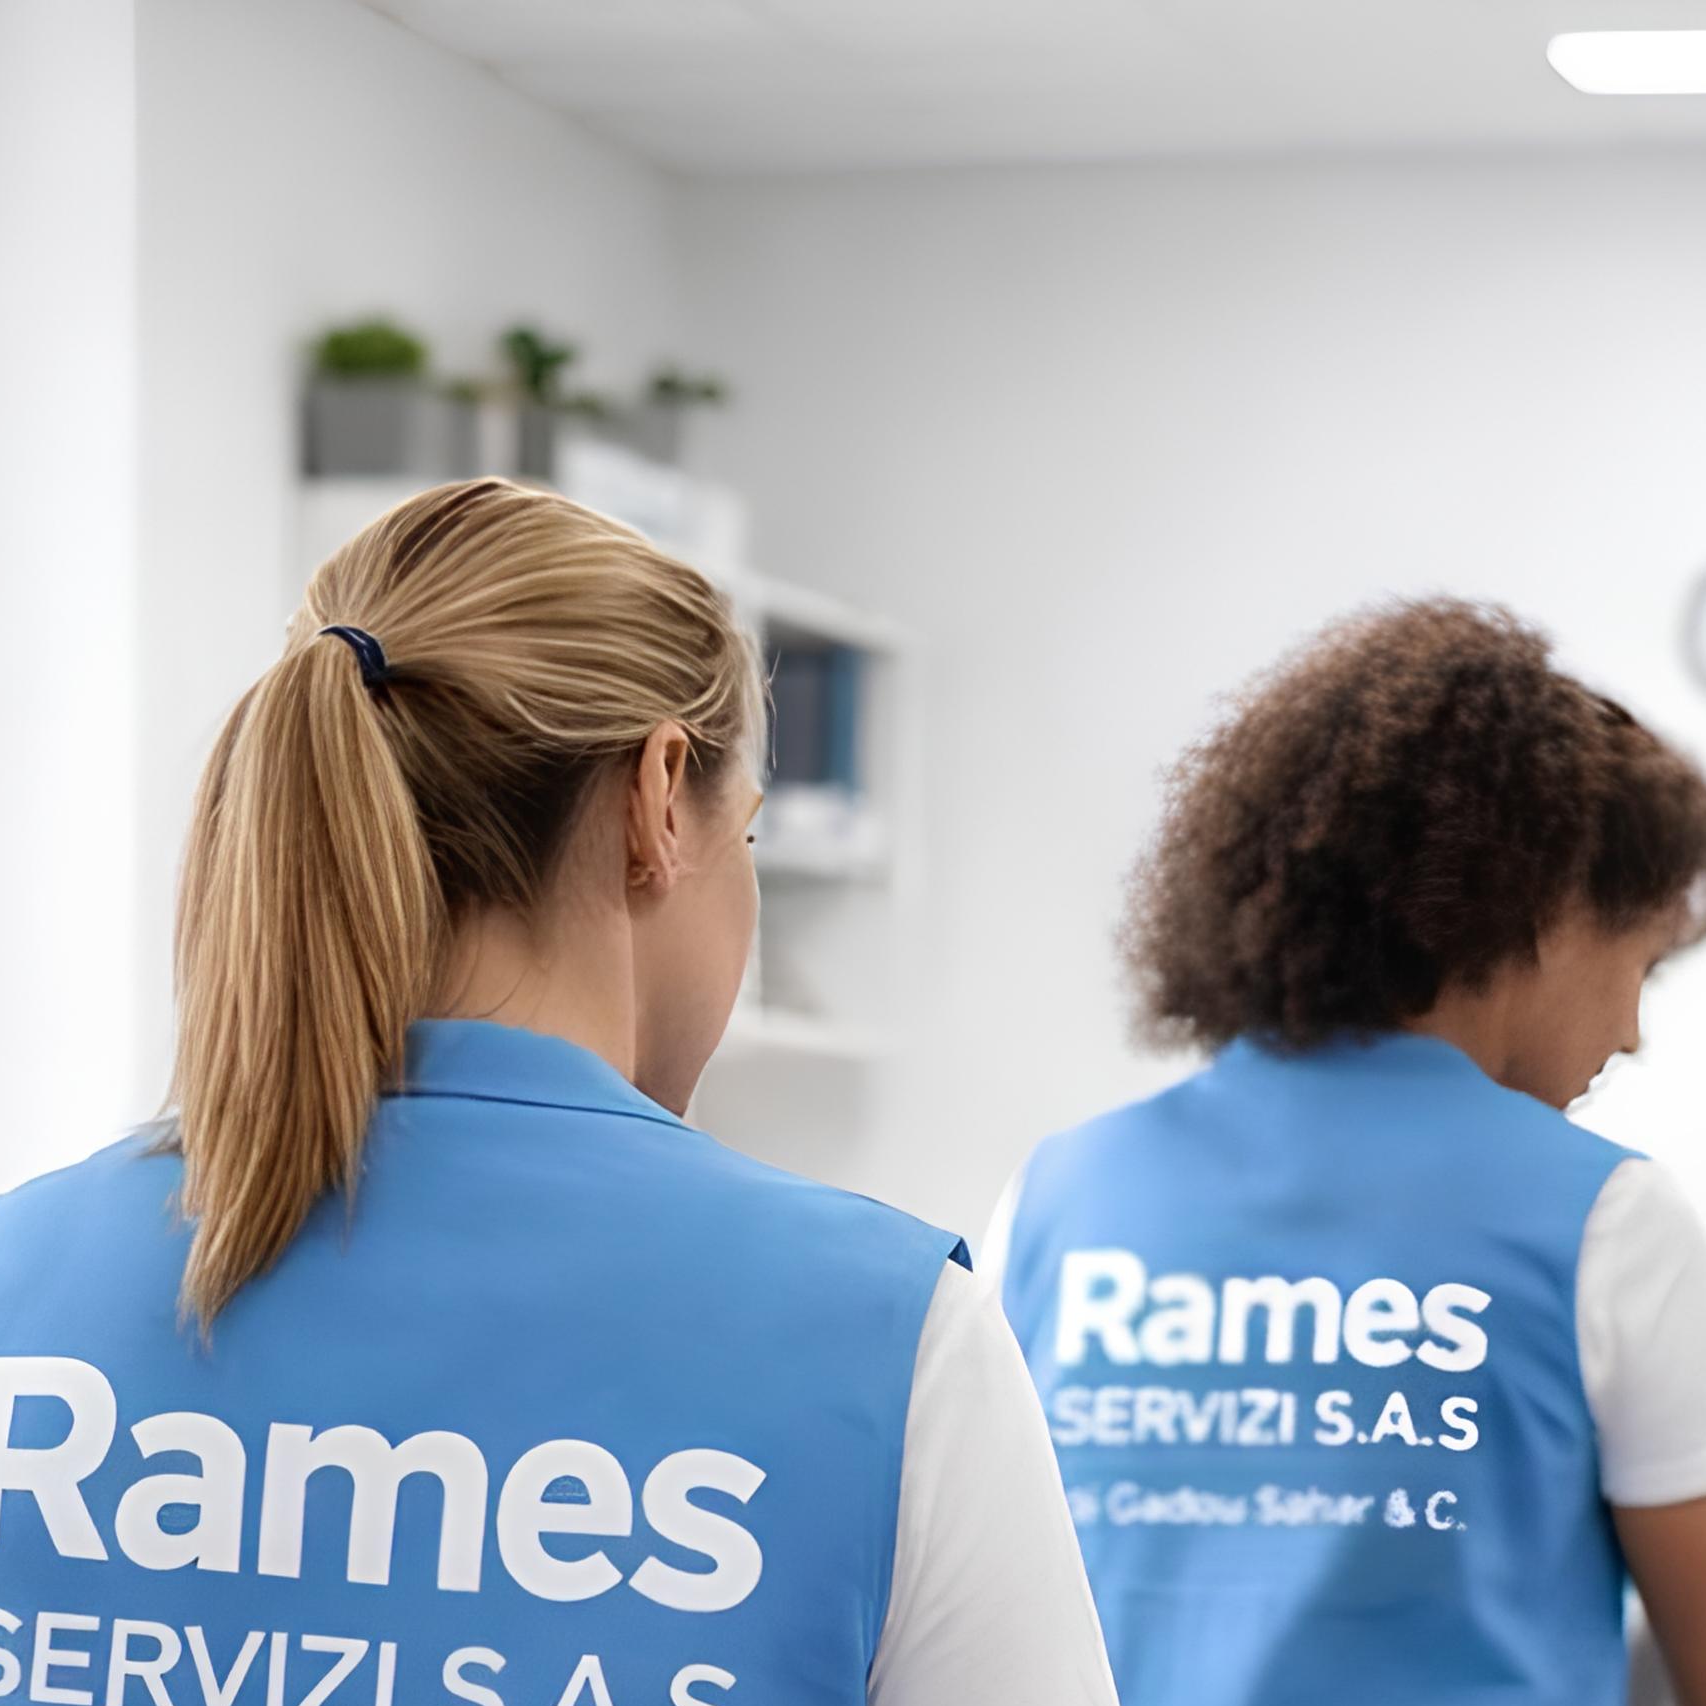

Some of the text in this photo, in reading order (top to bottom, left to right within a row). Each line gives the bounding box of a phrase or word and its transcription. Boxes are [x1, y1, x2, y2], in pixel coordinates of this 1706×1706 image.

[1055, 1248, 1492, 1373] Rames
[1052, 1385, 1480, 1452] SERVIZI S.A.S
